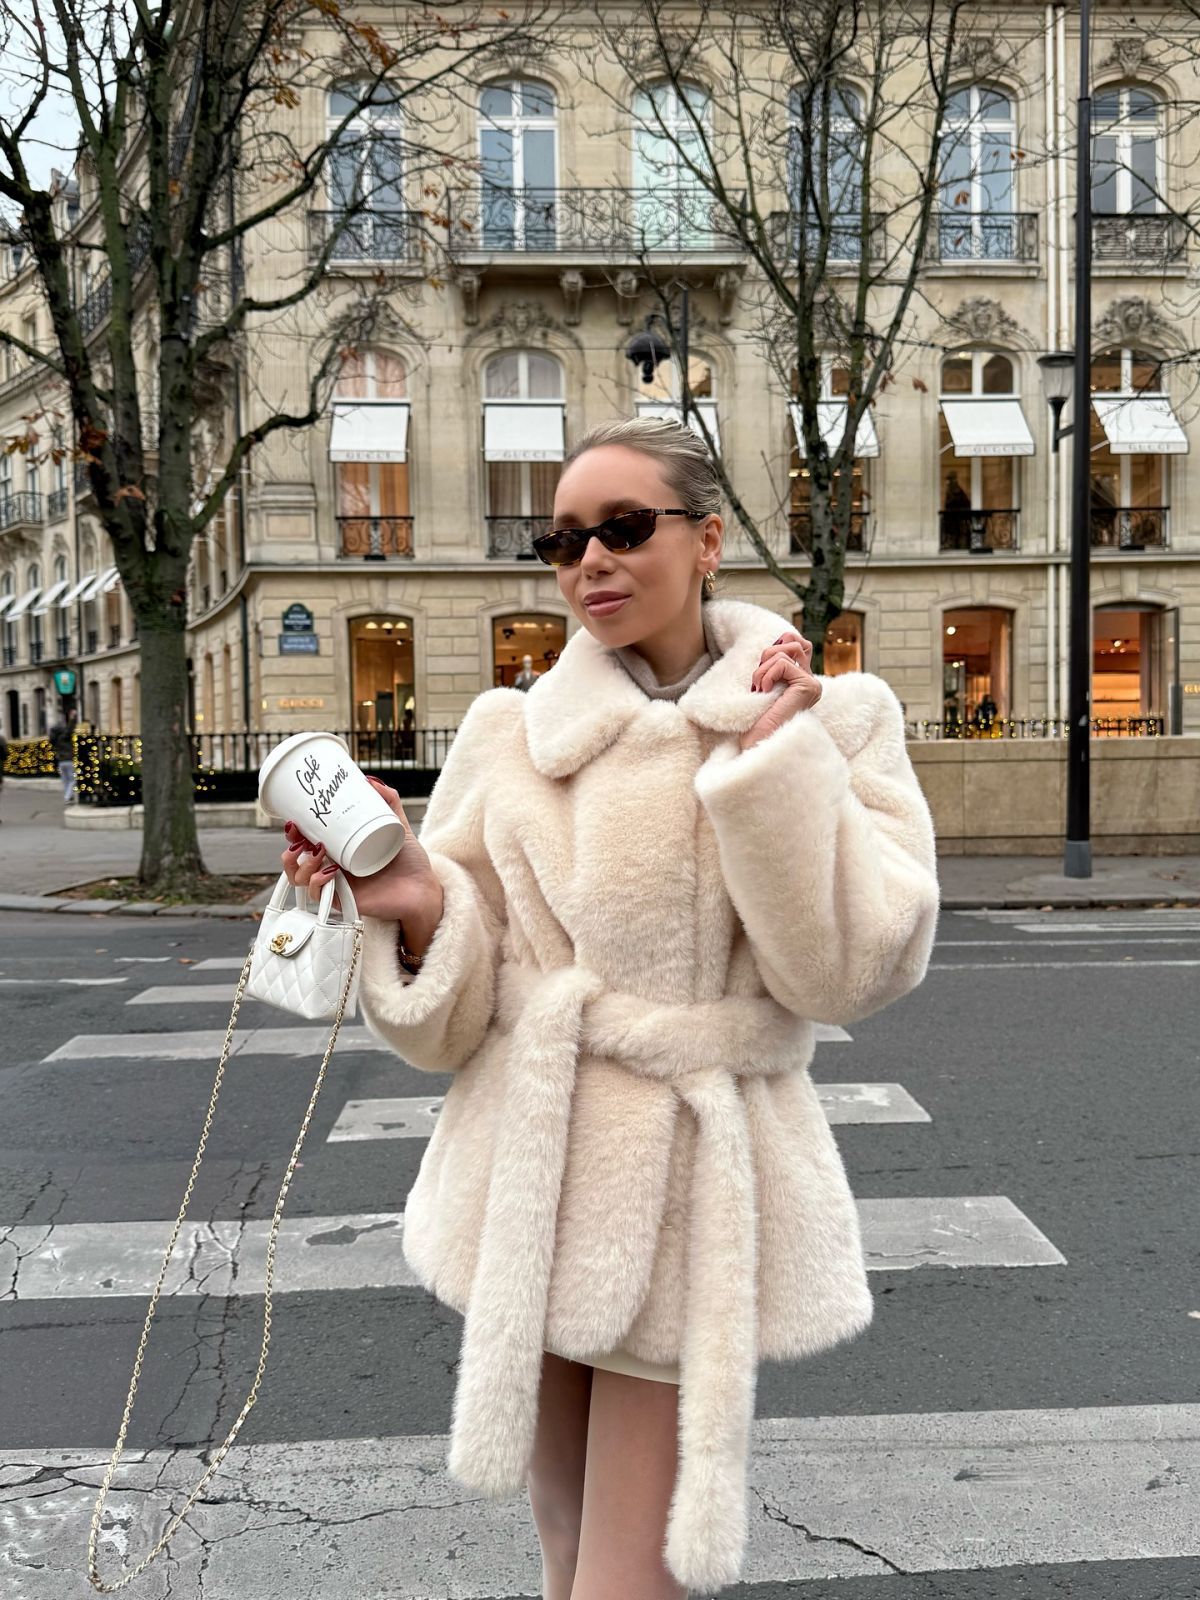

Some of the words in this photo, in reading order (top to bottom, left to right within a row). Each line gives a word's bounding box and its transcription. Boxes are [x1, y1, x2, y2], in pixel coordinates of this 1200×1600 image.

[1128, 444, 1170, 452] GUCCI
[345, 451, 391, 459] GUCCI
[503, 451, 546, 459] GUCCI
[296, 755, 320, 796] Café
[310, 765, 349, 828] Kitsuné
